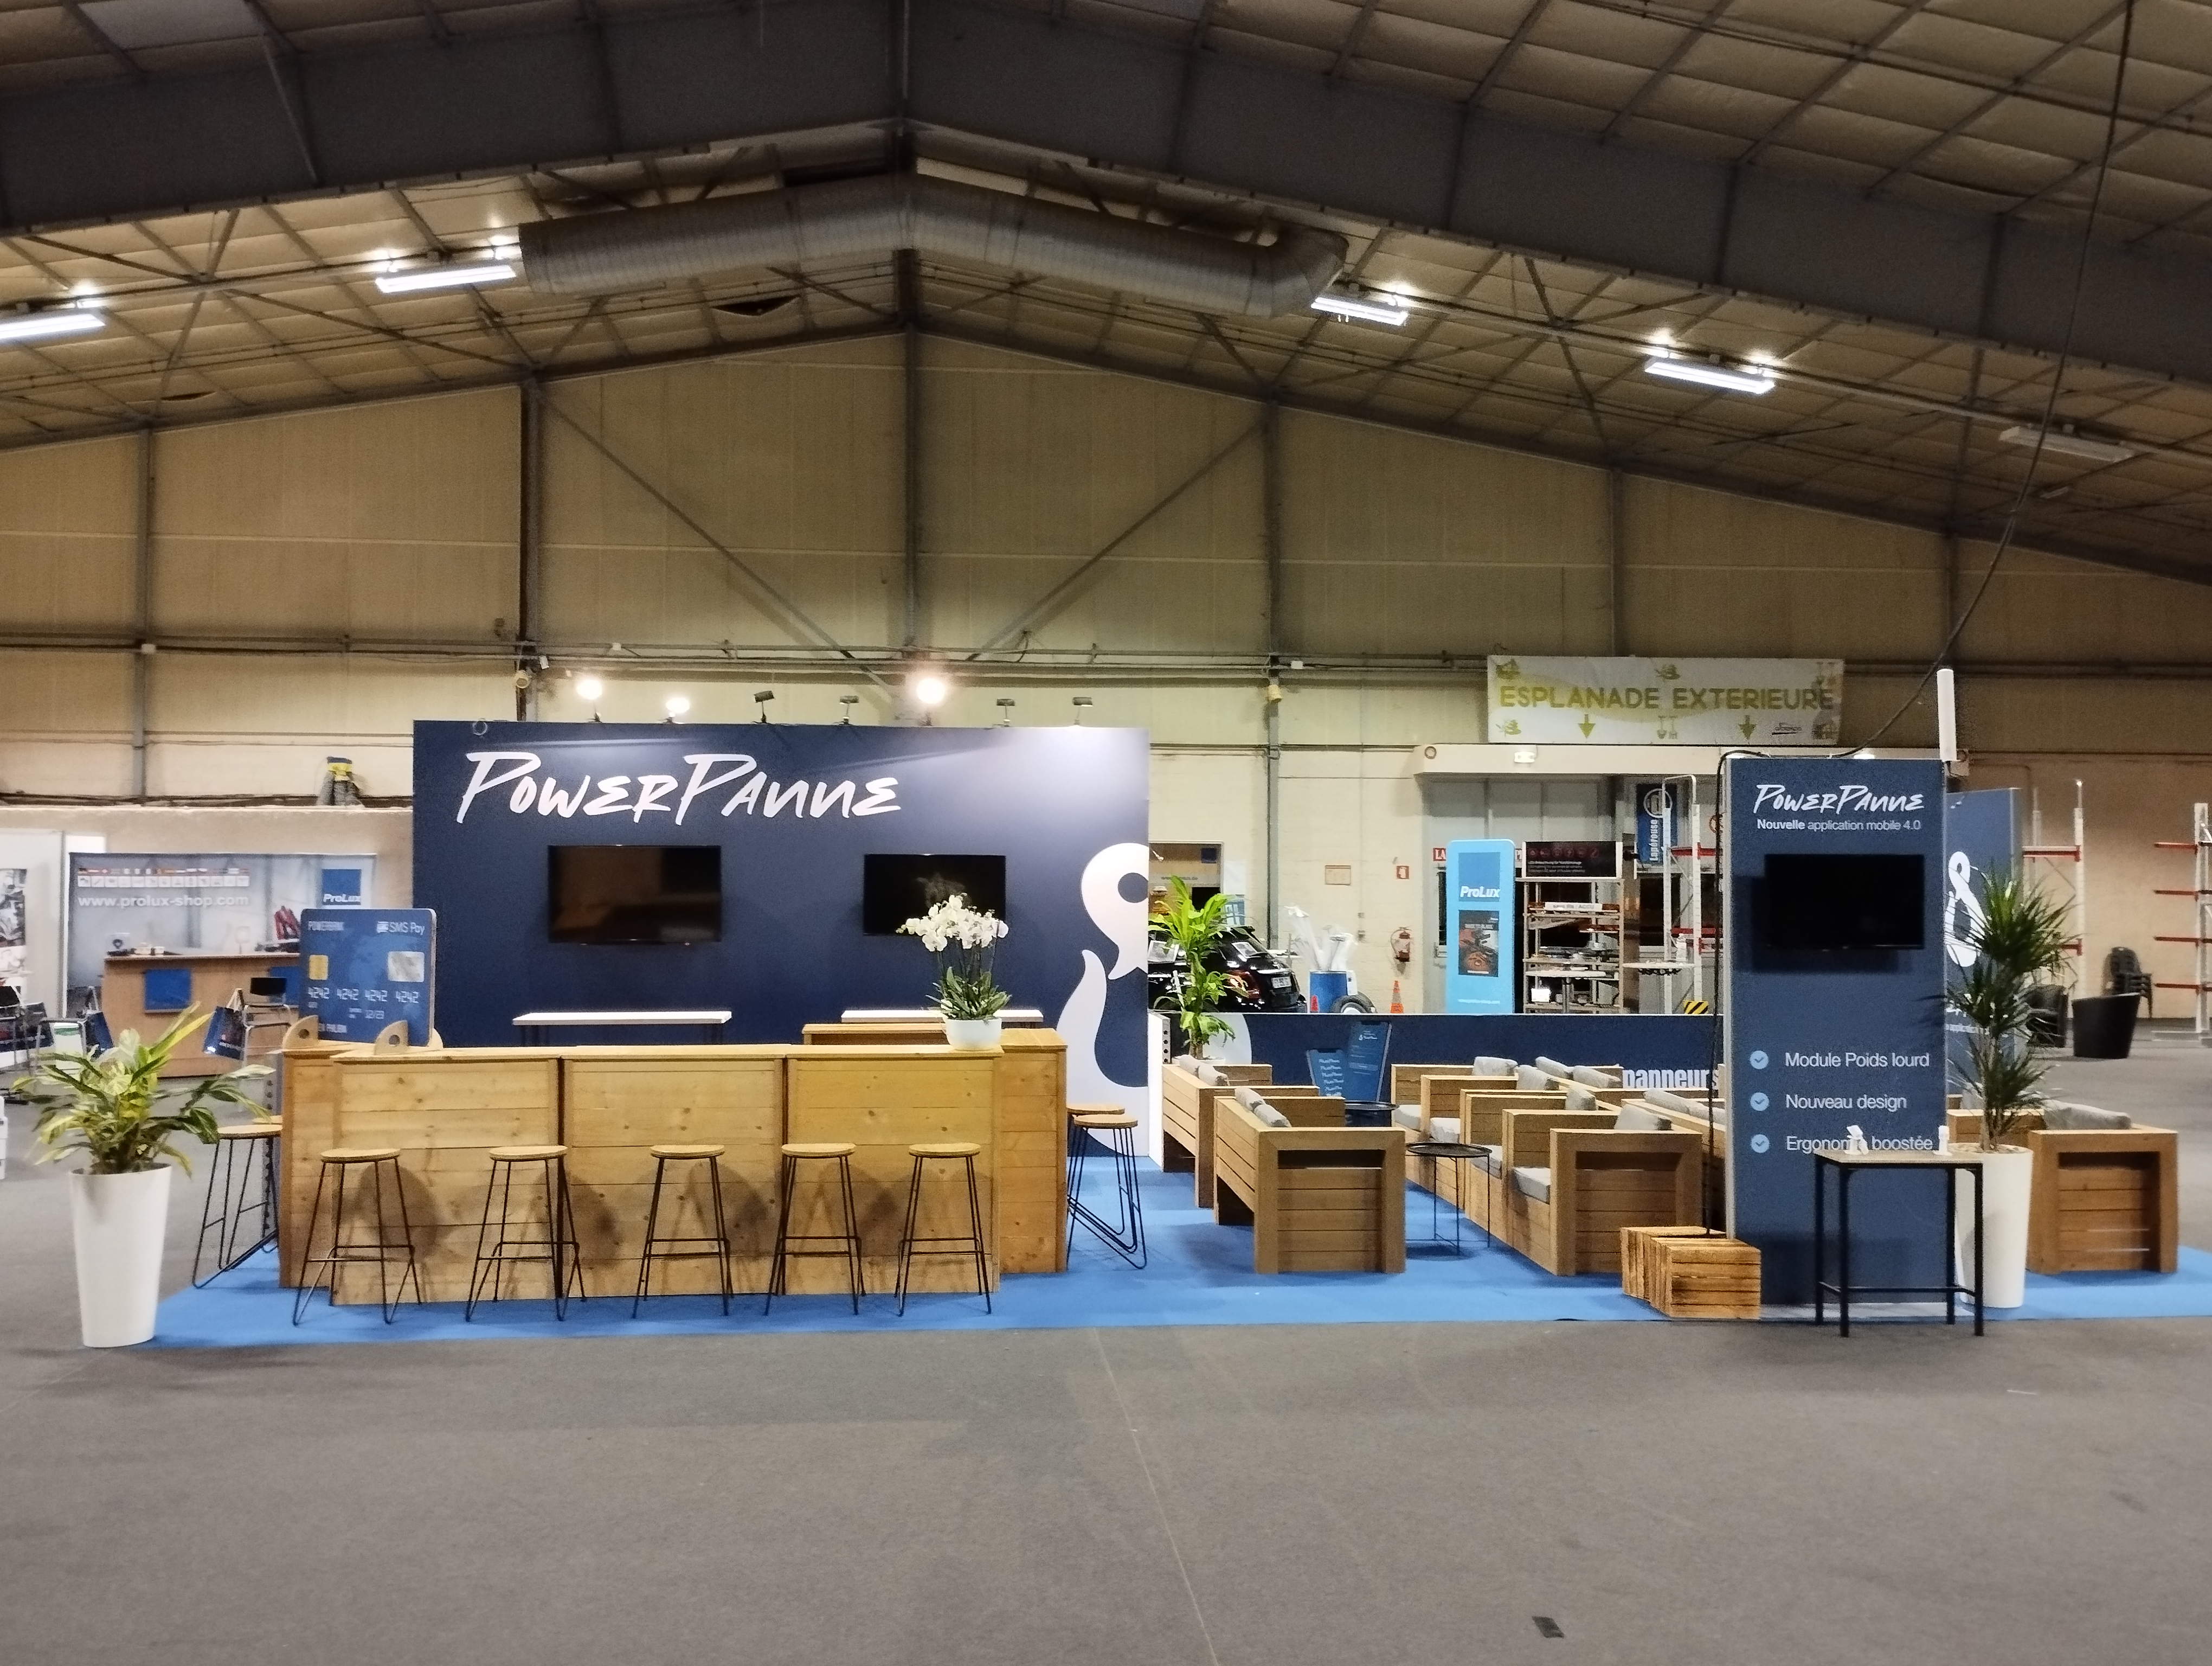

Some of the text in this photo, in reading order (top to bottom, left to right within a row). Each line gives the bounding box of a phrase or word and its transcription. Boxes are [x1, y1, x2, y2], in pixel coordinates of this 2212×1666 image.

[1500, 686, 1834, 710] ESPLANADE EXTERIEURE
[1757, 819, 1921, 831] Nouvelle application mobile 4.0
[323, 893, 362, 902] ProLux
[1460, 886, 1500, 898] ProLux
[78, 895, 249, 908] www.prolux-shop.com
[1785, 1053, 1930, 1067] Module Poids lourd
[1786, 1094, 1907, 1112] Nouveau design
[1786, 1136, 1933, 1154] Ergonom boostée
